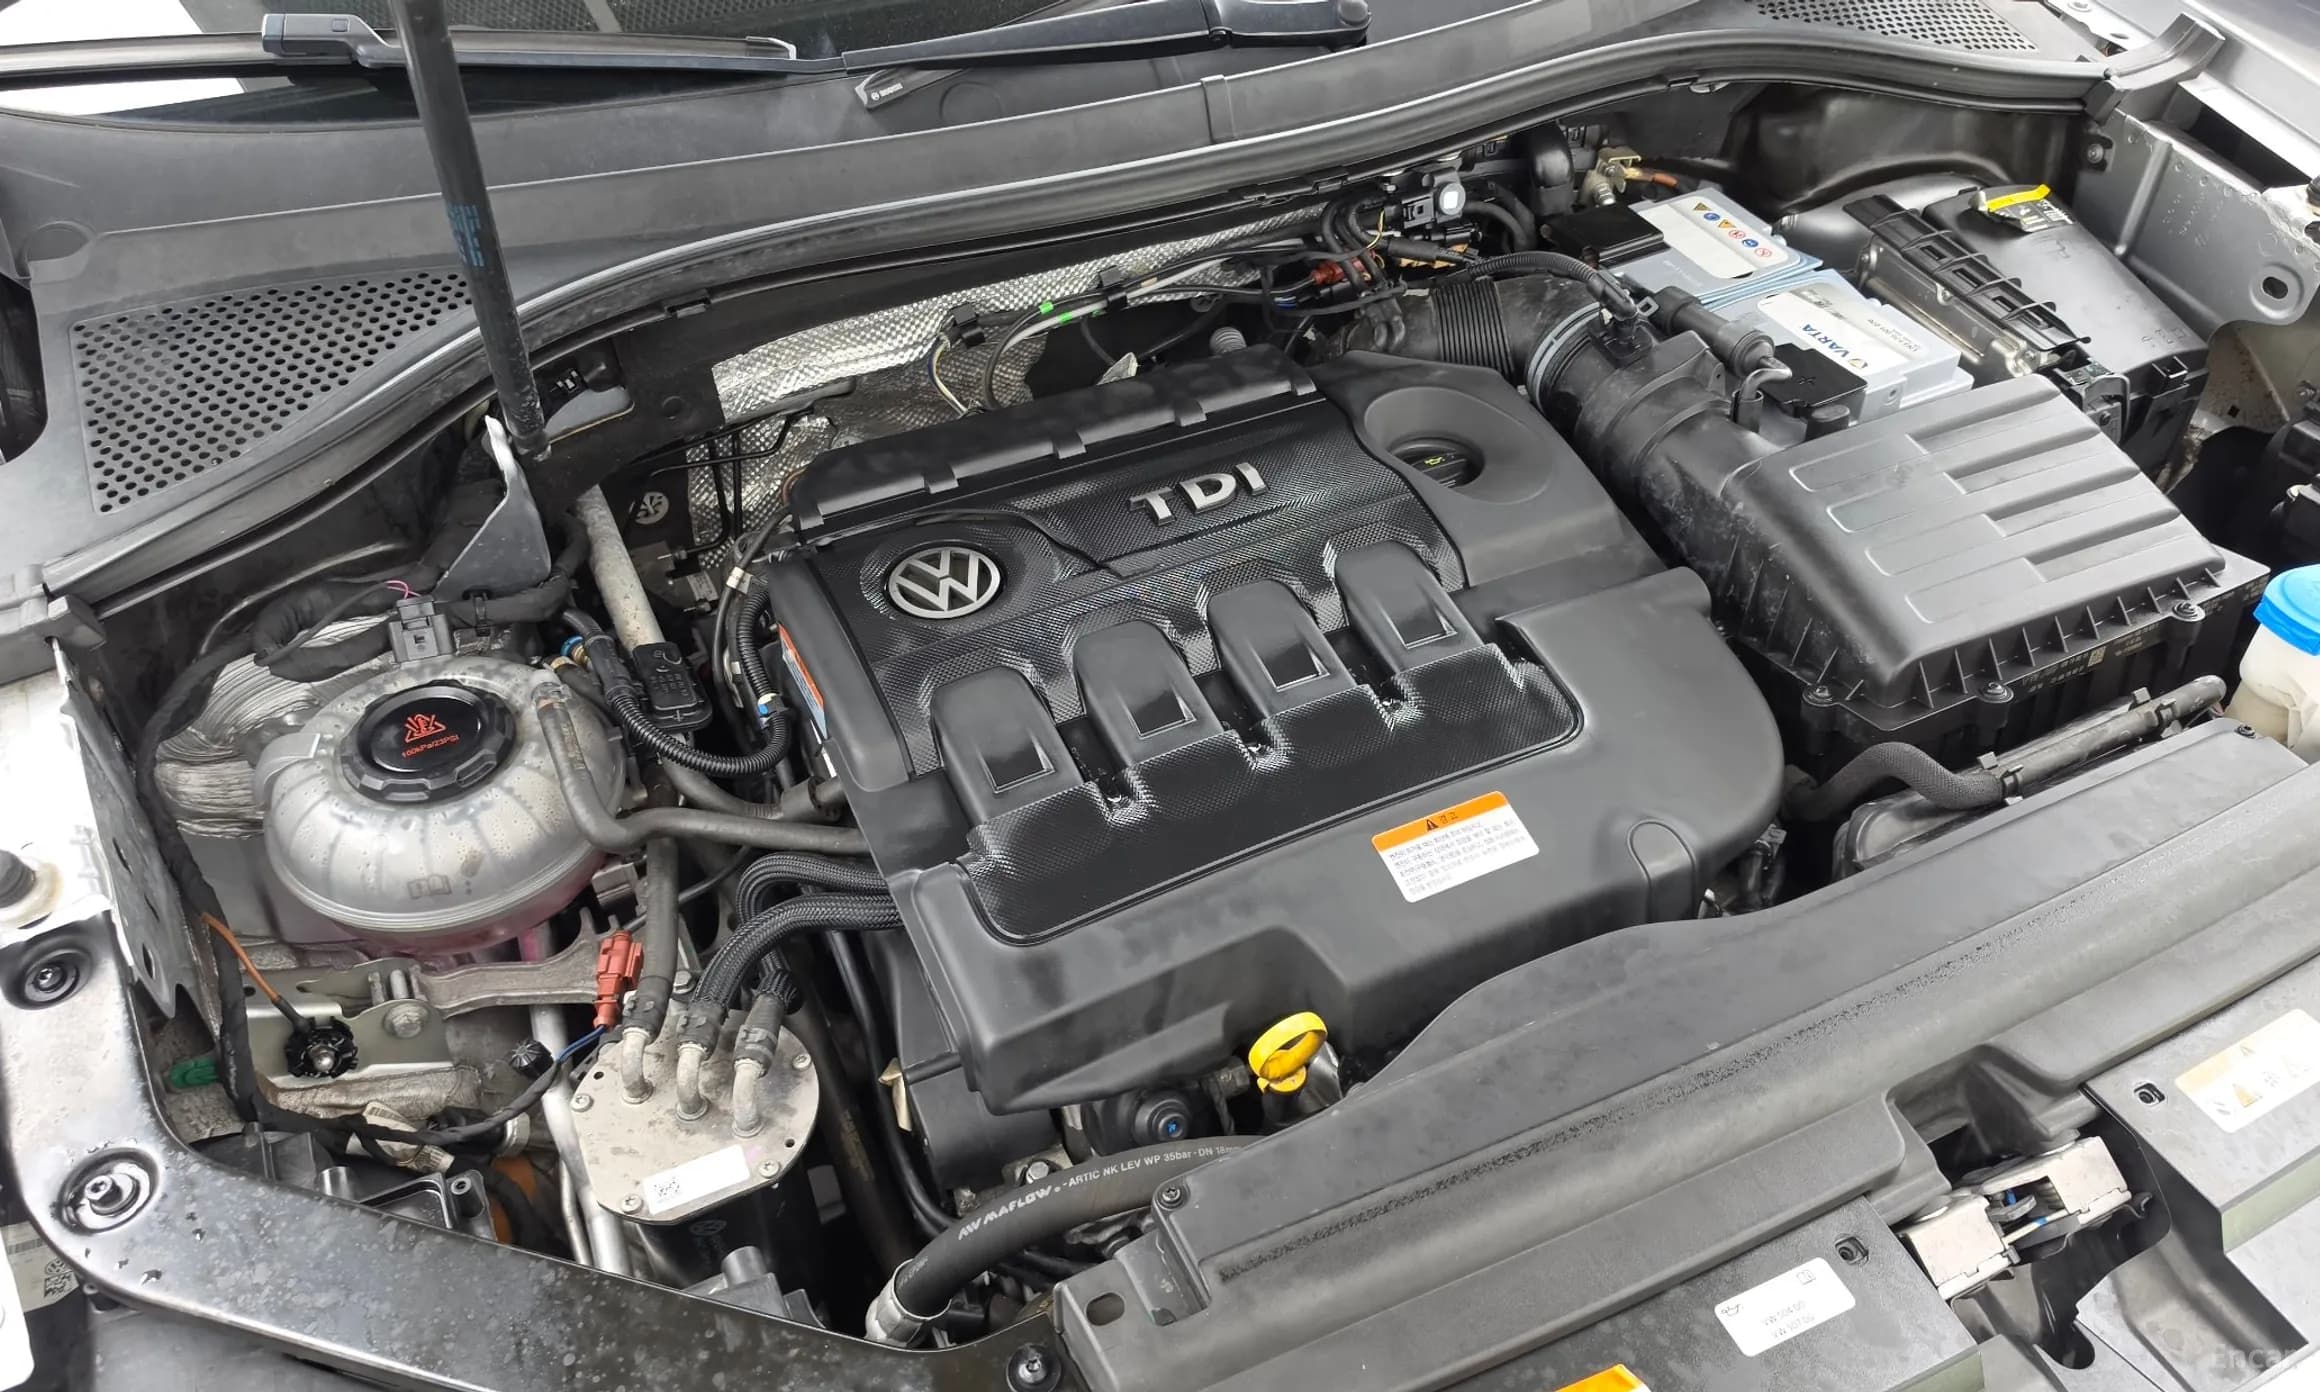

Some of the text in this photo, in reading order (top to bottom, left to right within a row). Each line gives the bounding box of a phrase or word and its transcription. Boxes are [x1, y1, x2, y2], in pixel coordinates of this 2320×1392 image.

[1801, 323, 1850, 358] VARTA
[1130, 462, 1269, 526] TDI
[889, 547, 1000, 618] VW
[983, 1185, 1052, 1225] MAFLOW
[1103, 1165, 1119, 1177] NK
[1121, 1158, 1141, 1172] LEV
[1144, 1154, 1161, 1166] WP
